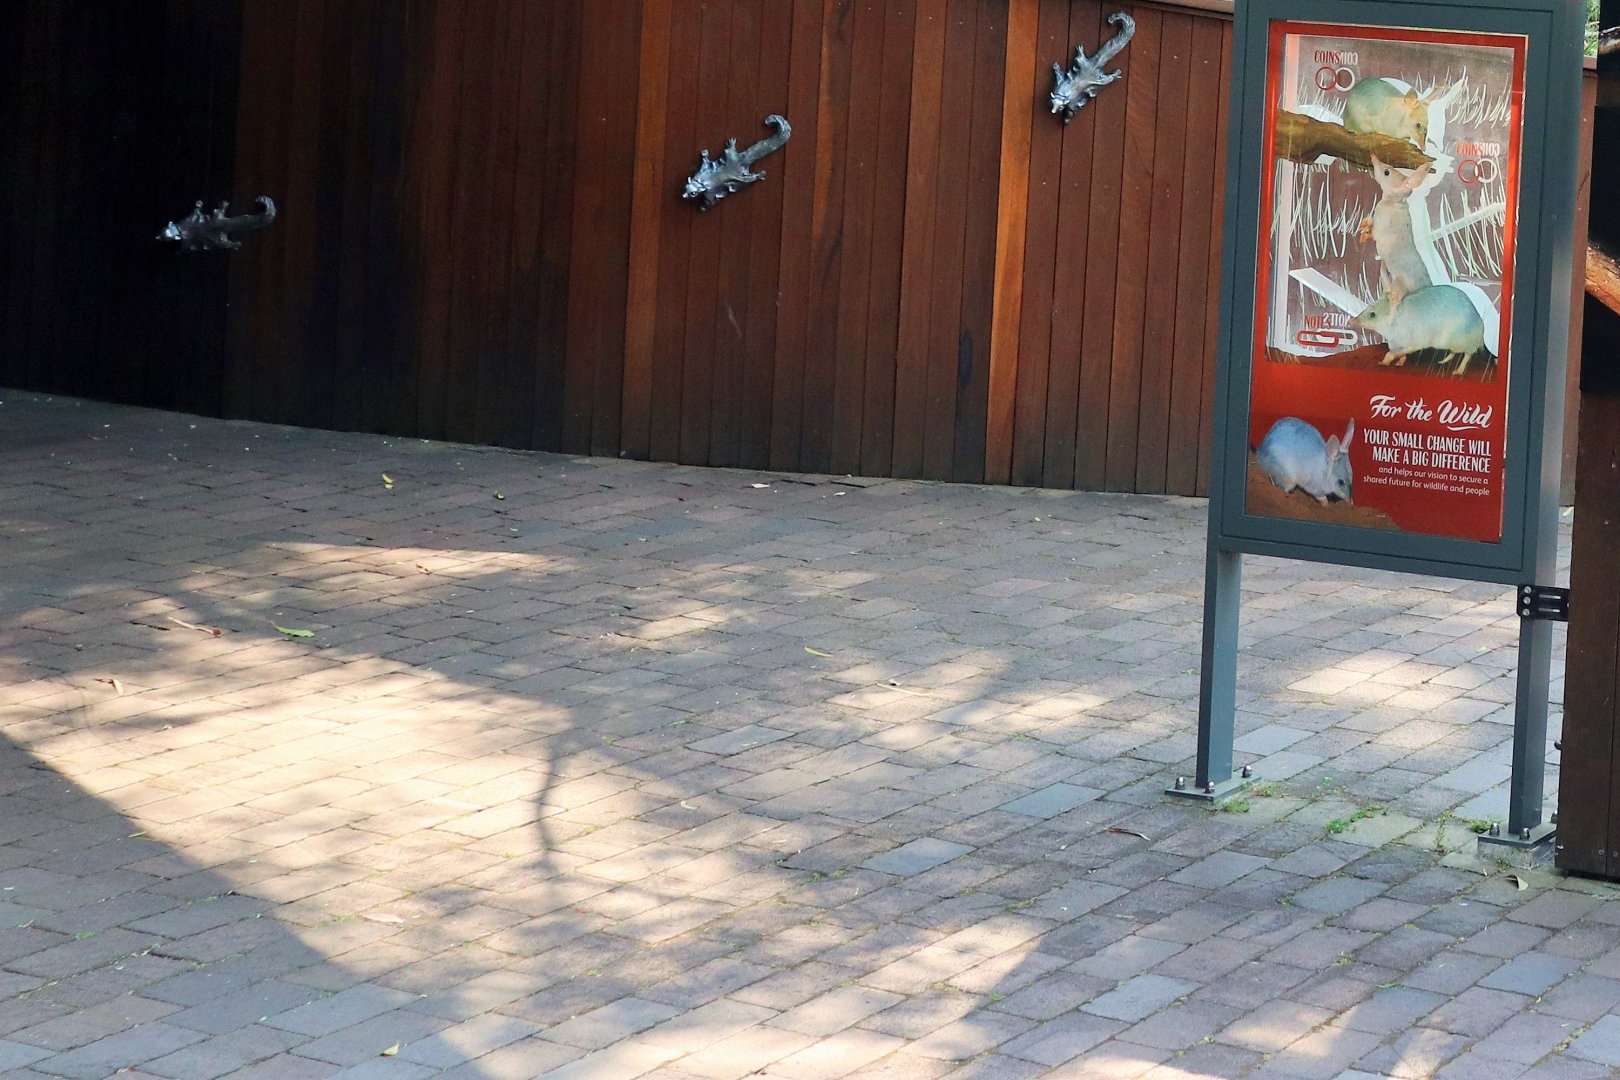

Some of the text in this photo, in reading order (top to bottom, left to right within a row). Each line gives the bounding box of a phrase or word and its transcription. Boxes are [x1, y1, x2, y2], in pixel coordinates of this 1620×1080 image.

[1314, 50, 1340, 64] COINS
[1370, 395, 1493, 429] For the Wild
[1363, 428, 1492, 457] YOUR SMALL CHANGE WILL
[1372, 446, 1491, 474] MAKE A BIG DIFFERENCE
[1363, 474, 1490, 497] shared future for wildlife and people
[1378, 466, 1393, 475] and
[1394, 467, 1413, 478] helps
[1414, 470, 1427, 478] our
[1428, 471, 1448, 481] vision
[1449, 473, 1458, 482] to
[1459, 476, 1482, 485] secure
